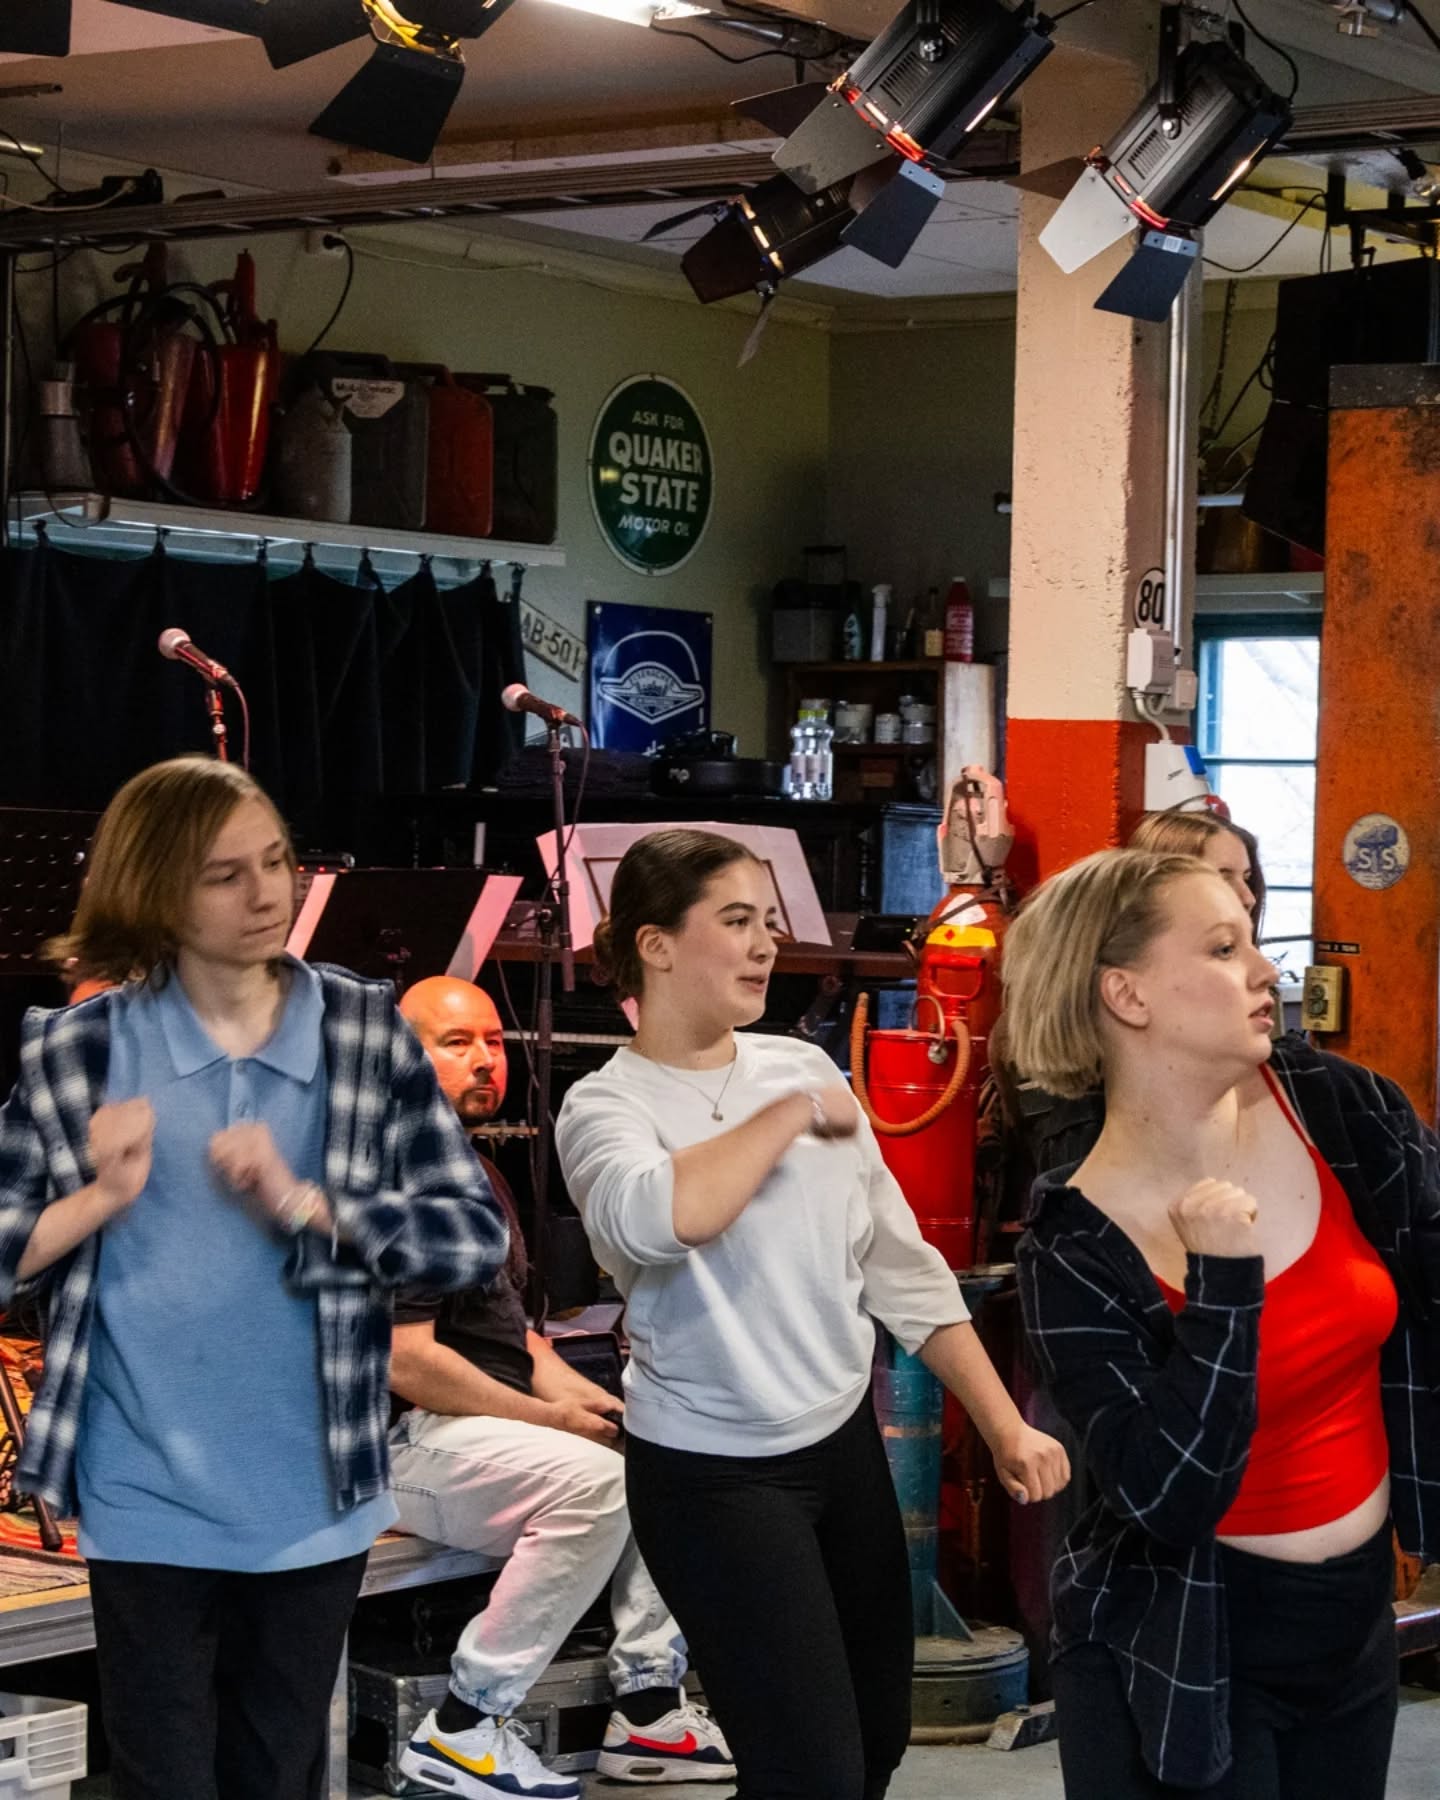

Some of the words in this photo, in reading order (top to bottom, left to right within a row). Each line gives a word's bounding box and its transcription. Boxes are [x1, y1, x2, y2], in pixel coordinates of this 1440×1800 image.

[632, 409, 658, 427] ASK
[663, 414, 686, 431] FOR
[608, 430, 704, 476] QUAKER
[618, 471, 700, 513] STATE
[617, 513, 671, 535] MOTOR
[1138, 579, 1165, 625] 80
